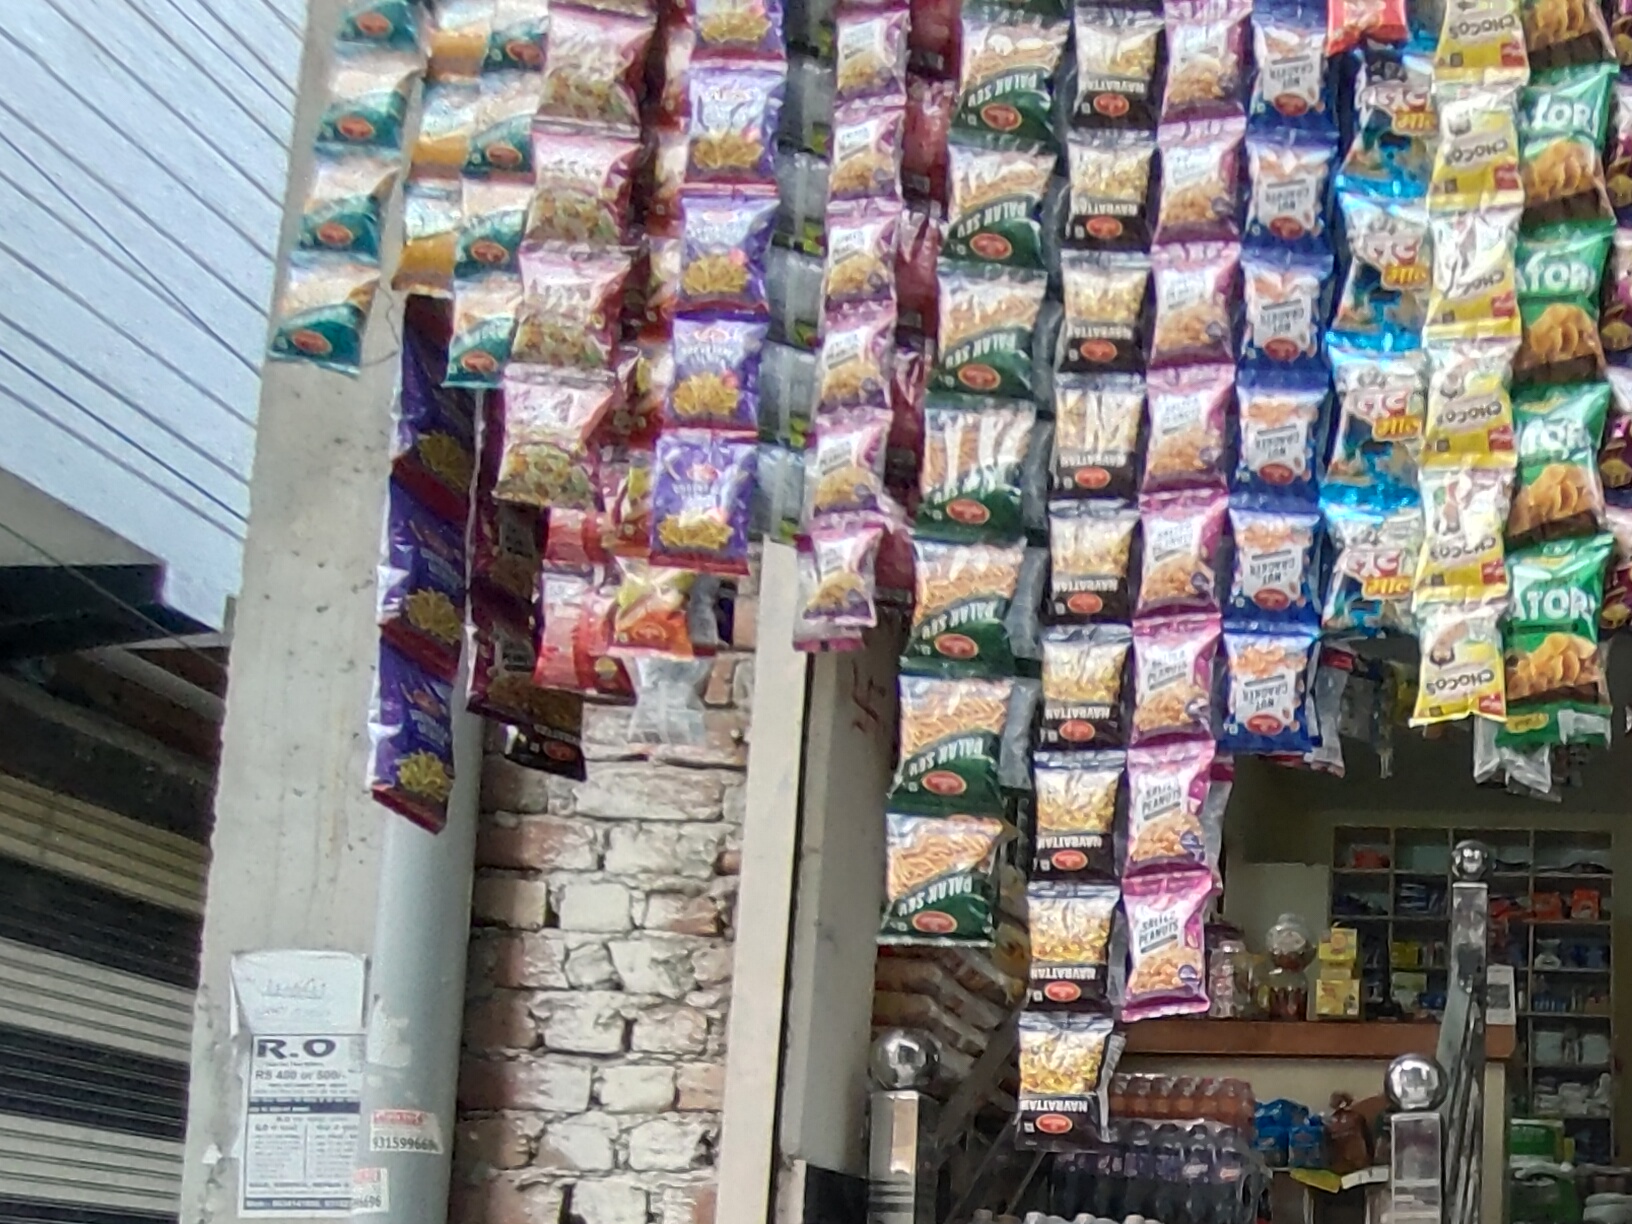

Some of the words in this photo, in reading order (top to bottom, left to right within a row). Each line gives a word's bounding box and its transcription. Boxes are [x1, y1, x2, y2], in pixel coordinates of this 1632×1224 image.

[1449, 14, 1516, 39] CHOCOS
[967, 84, 992, 108] SEV
[994, 72, 1038, 97] PALAK
[956, 213, 981, 238] SEV
[983, 201, 1028, 226] PALAK
[949, 600, 994, 628] PALAK
[1426, 670, 1496, 697] CHOCOS
[1255, 697, 1275, 712] NUT
[938, 736, 984, 759] PALAK
[930, 876, 973, 904] PALAK
[256, 1039, 336, 1059] R.O
